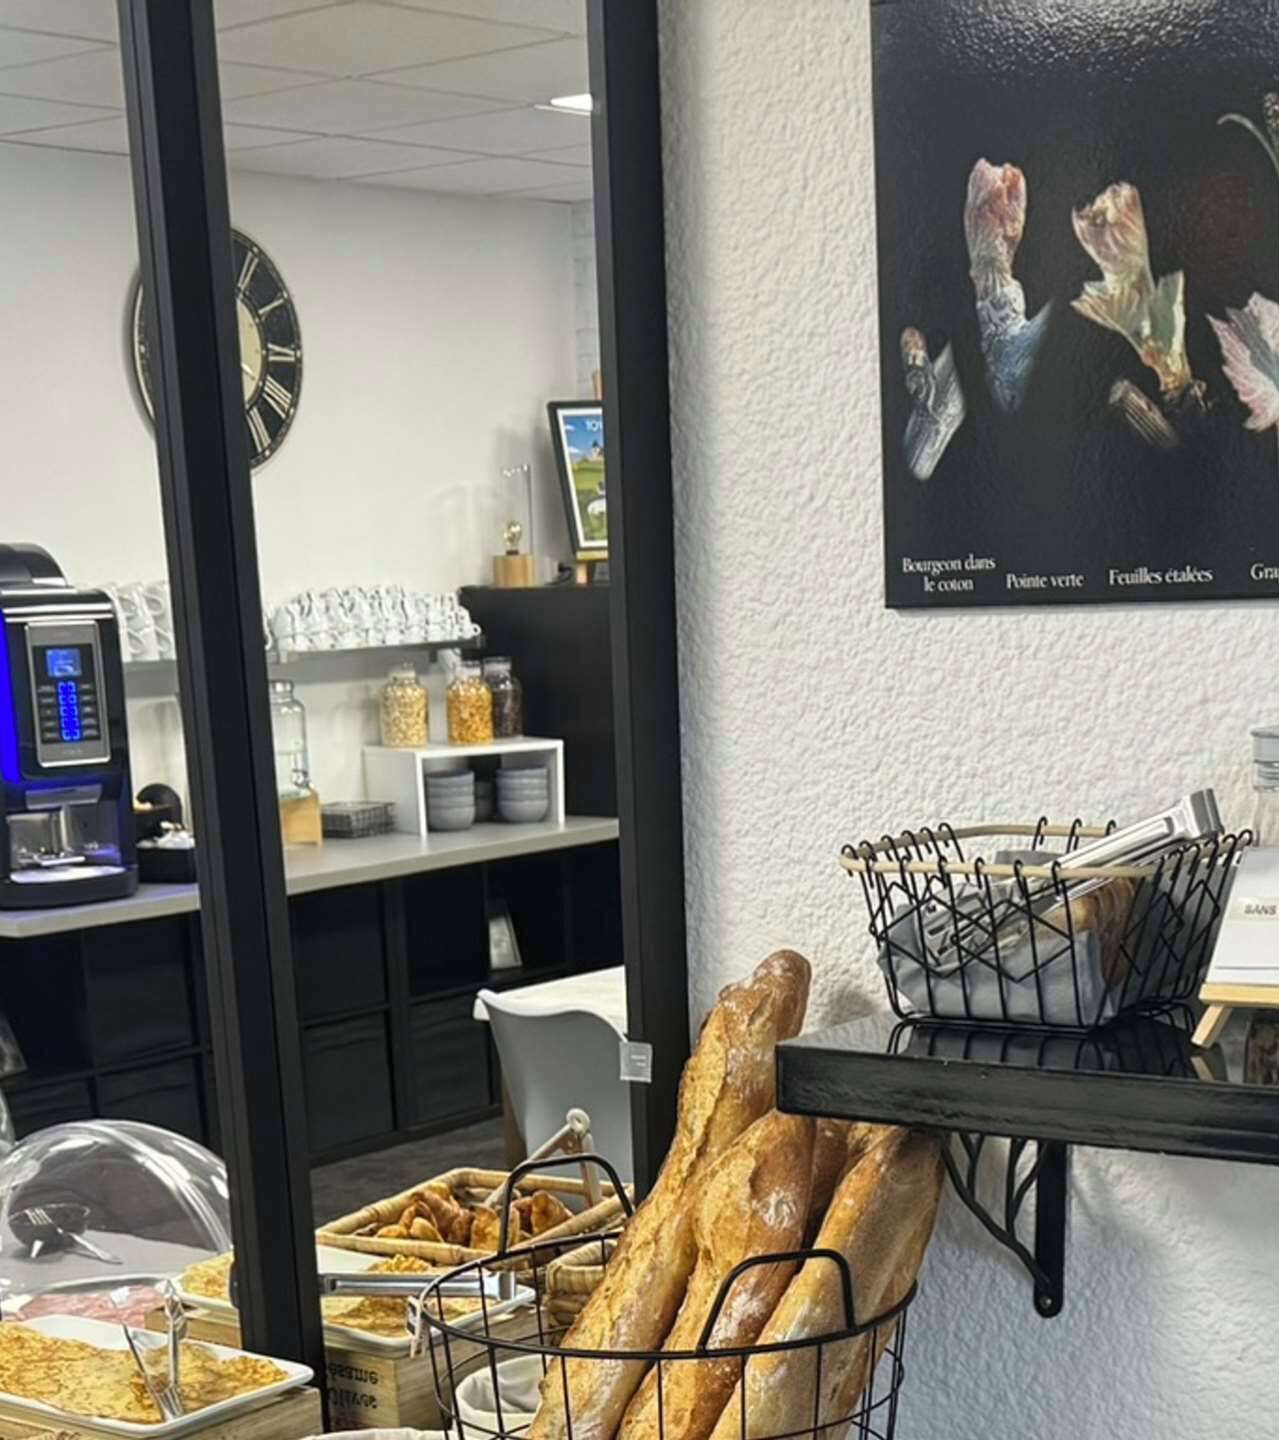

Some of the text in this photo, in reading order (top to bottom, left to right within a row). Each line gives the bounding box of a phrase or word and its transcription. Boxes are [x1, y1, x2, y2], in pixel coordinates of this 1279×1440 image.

[902, 553, 996, 575] Bourgeon dans
[923, 576, 974, 592] le coton
[1006, 572, 1084, 590] Pointe verte
[1108, 565, 1213, 586] Feuilles étalées
[1244, 904, 1277, 916] SANS
